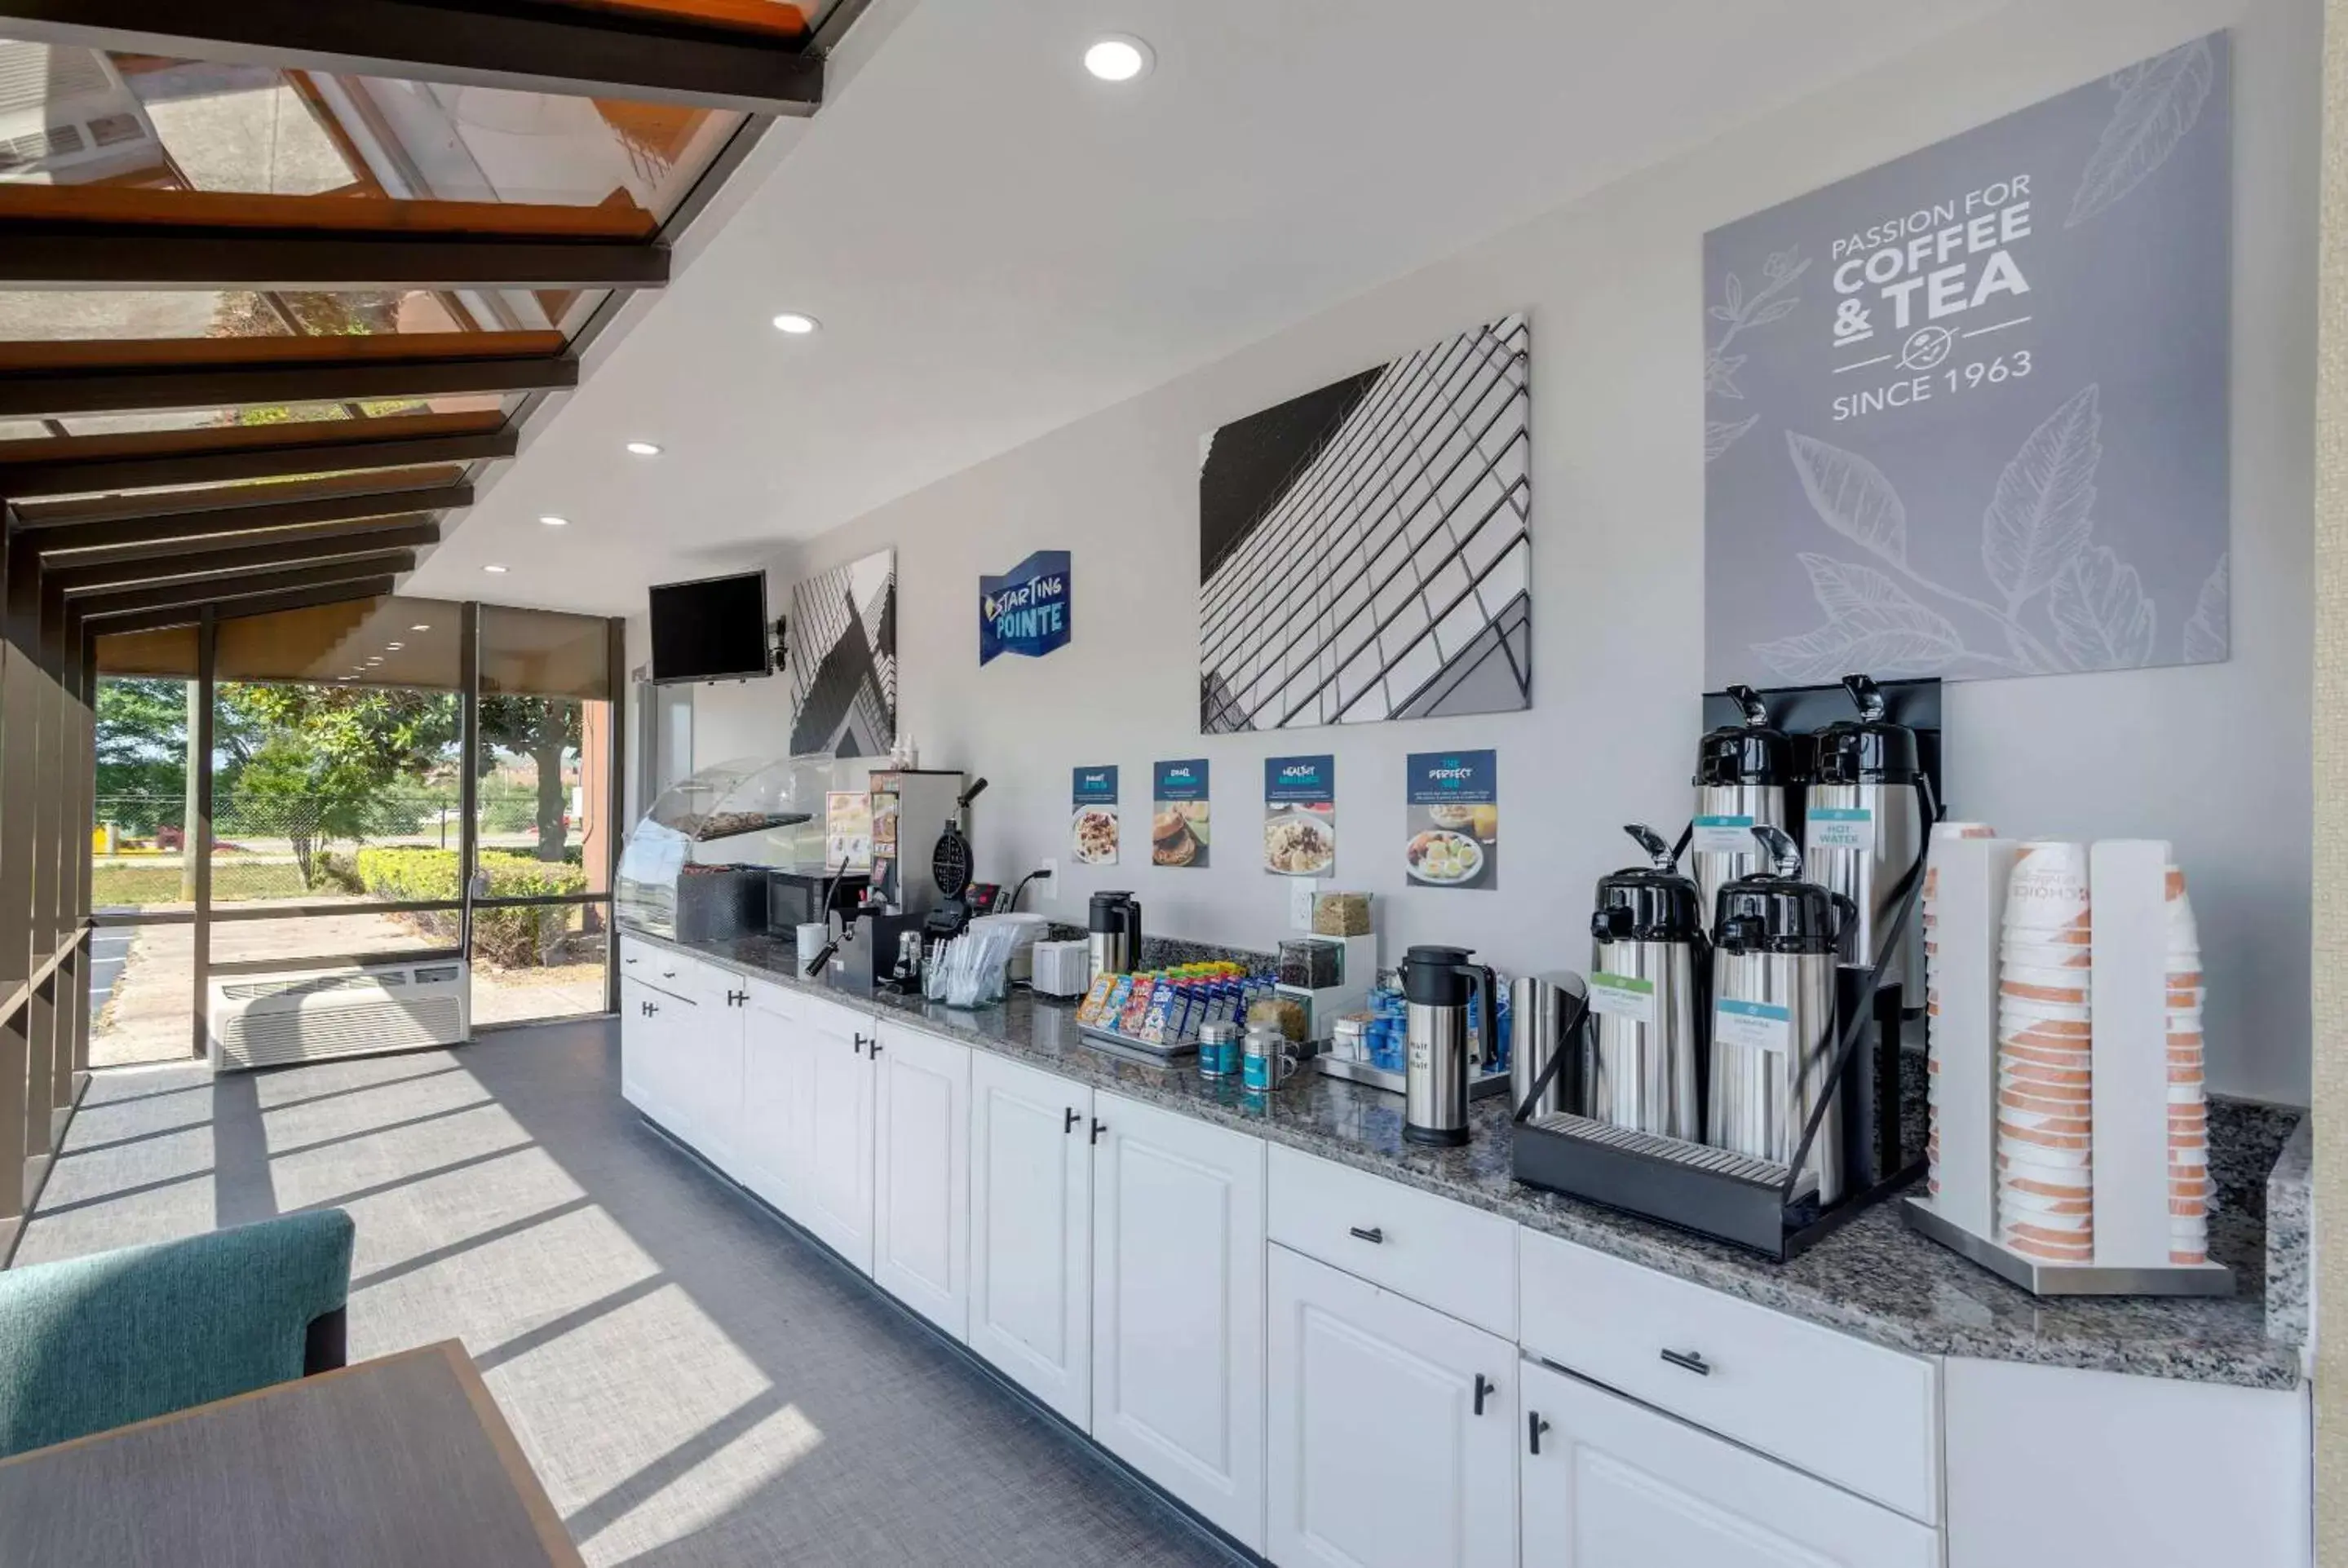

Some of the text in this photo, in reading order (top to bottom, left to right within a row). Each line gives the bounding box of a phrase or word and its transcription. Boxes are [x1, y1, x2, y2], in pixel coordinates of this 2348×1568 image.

[1833, 174, 2031, 261] PASSION FOR
[1833, 201, 2032, 294] COFFEE
[1833, 250, 2032, 338] & TEA
[1833, 350, 2032, 421] SINCE 1963
[997, 603, 1064, 639] POINTE
[1819, 834, 1859, 844] WATER
[1828, 825, 1852, 833] HOT
